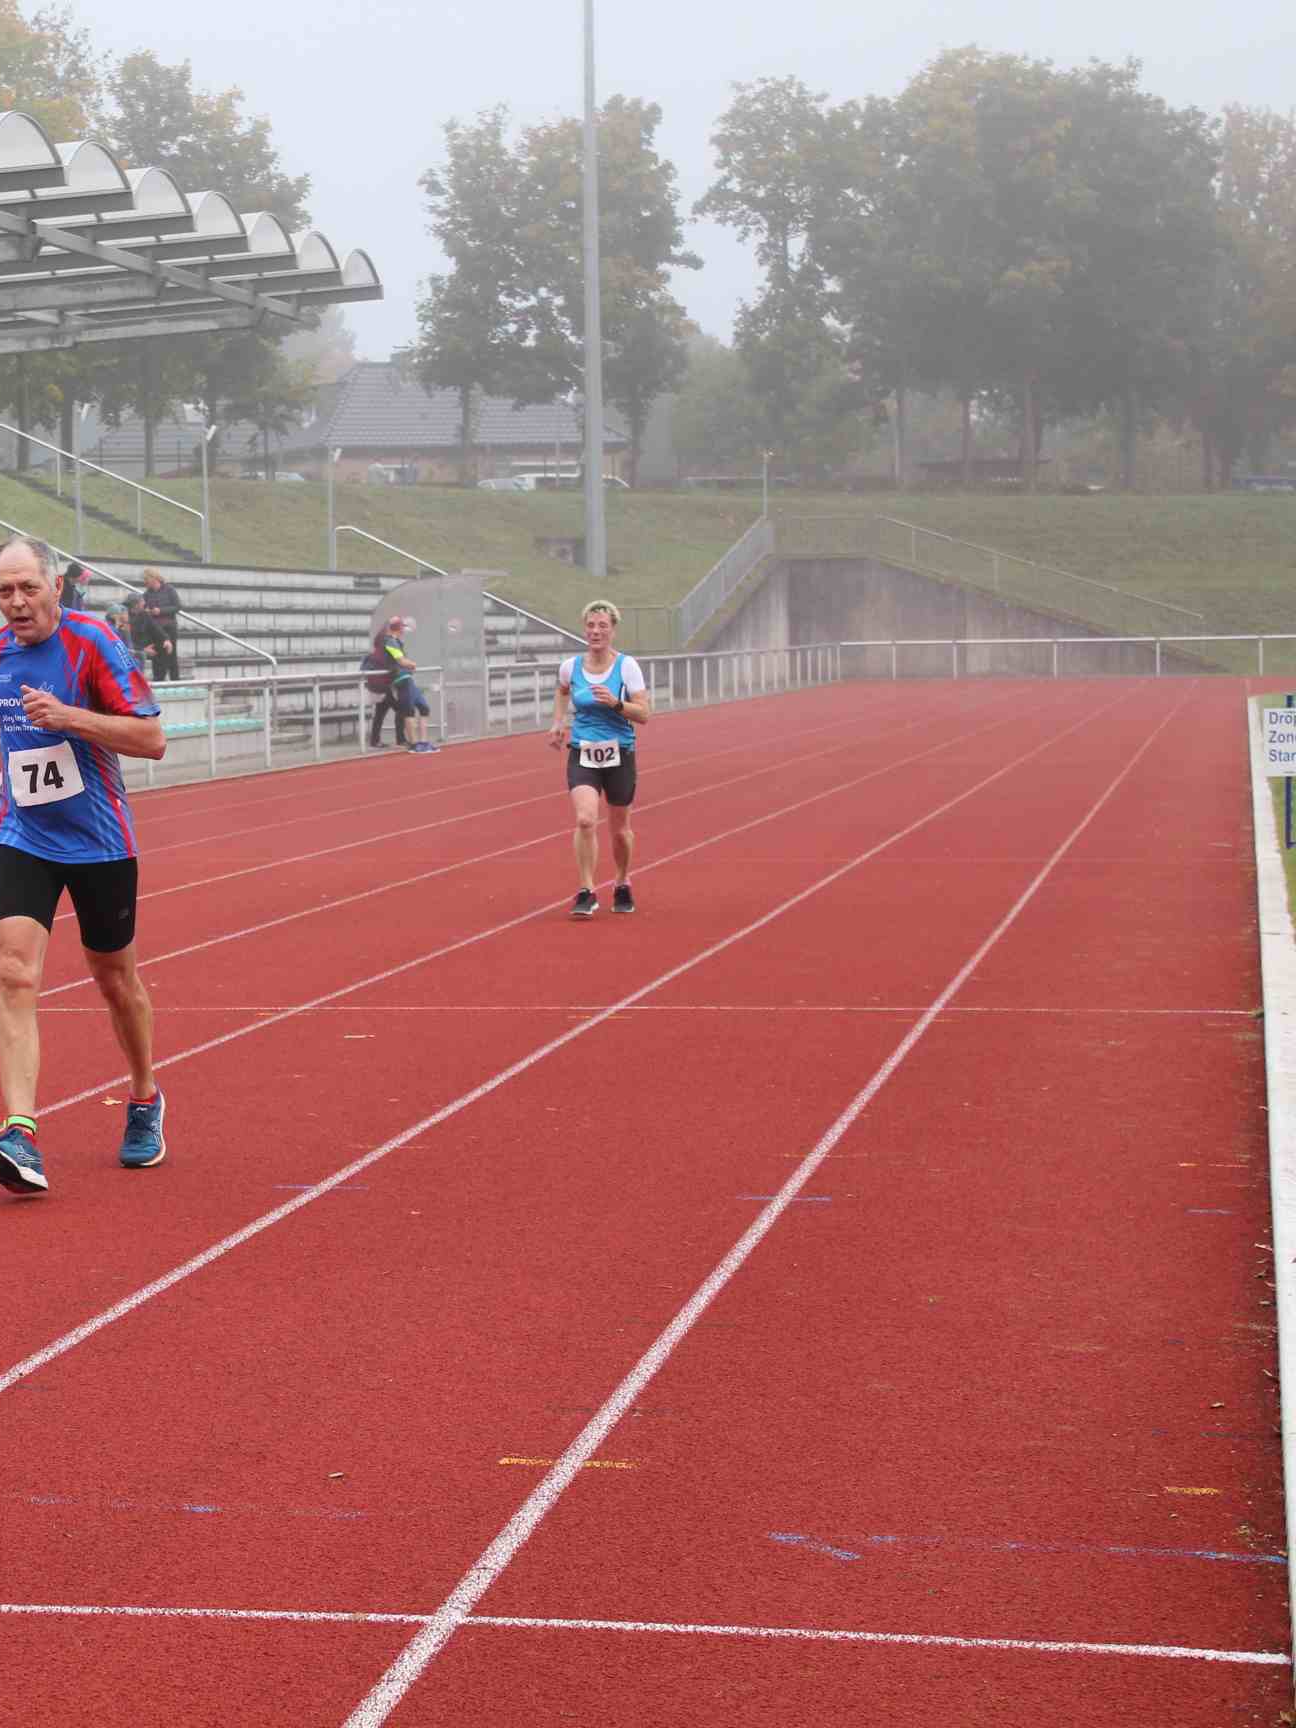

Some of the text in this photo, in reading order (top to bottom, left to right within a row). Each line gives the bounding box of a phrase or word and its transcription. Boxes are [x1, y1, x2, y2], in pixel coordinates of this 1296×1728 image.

[1268, 730, 1296, 743] Zon
[584, 746, 615, 763] 102
[21, 761, 65, 794] 74
